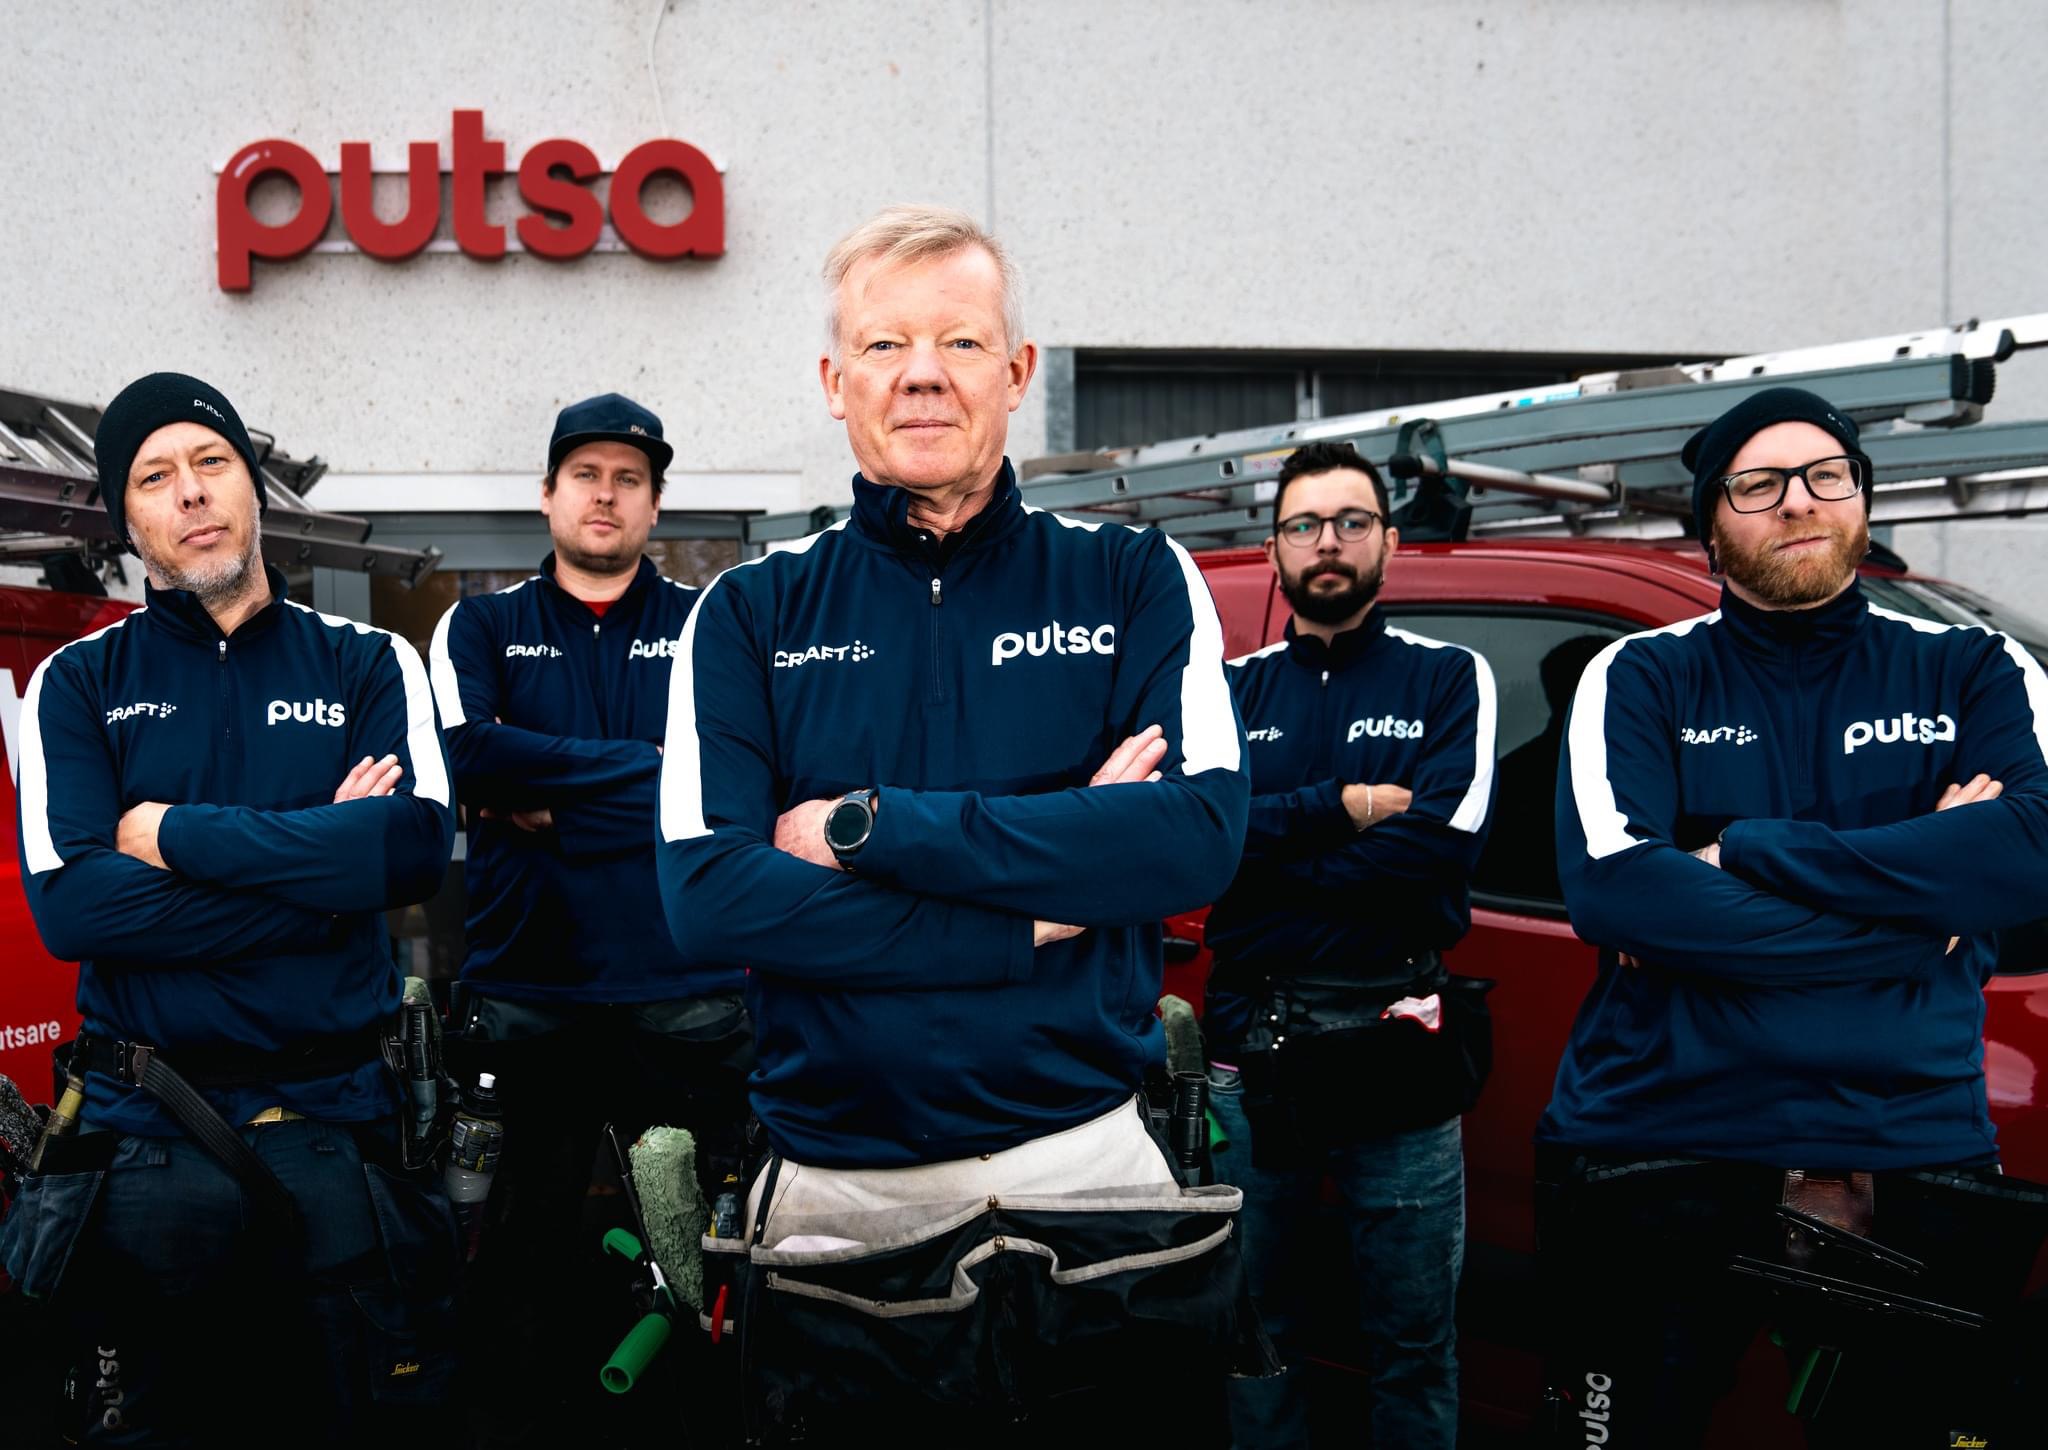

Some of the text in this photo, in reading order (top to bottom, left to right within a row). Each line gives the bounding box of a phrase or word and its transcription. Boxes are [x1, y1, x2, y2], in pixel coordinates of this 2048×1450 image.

[216, 109, 726, 292] putsa
[774, 645, 850, 667] CRAFT
[992, 619, 1115, 665] putsa
[267, 698, 346, 727] puts
[1347, 714, 1424, 743] putsa
[1844, 712, 1956, 754] putsa
[1579, 1372, 1612, 1450] utsa
